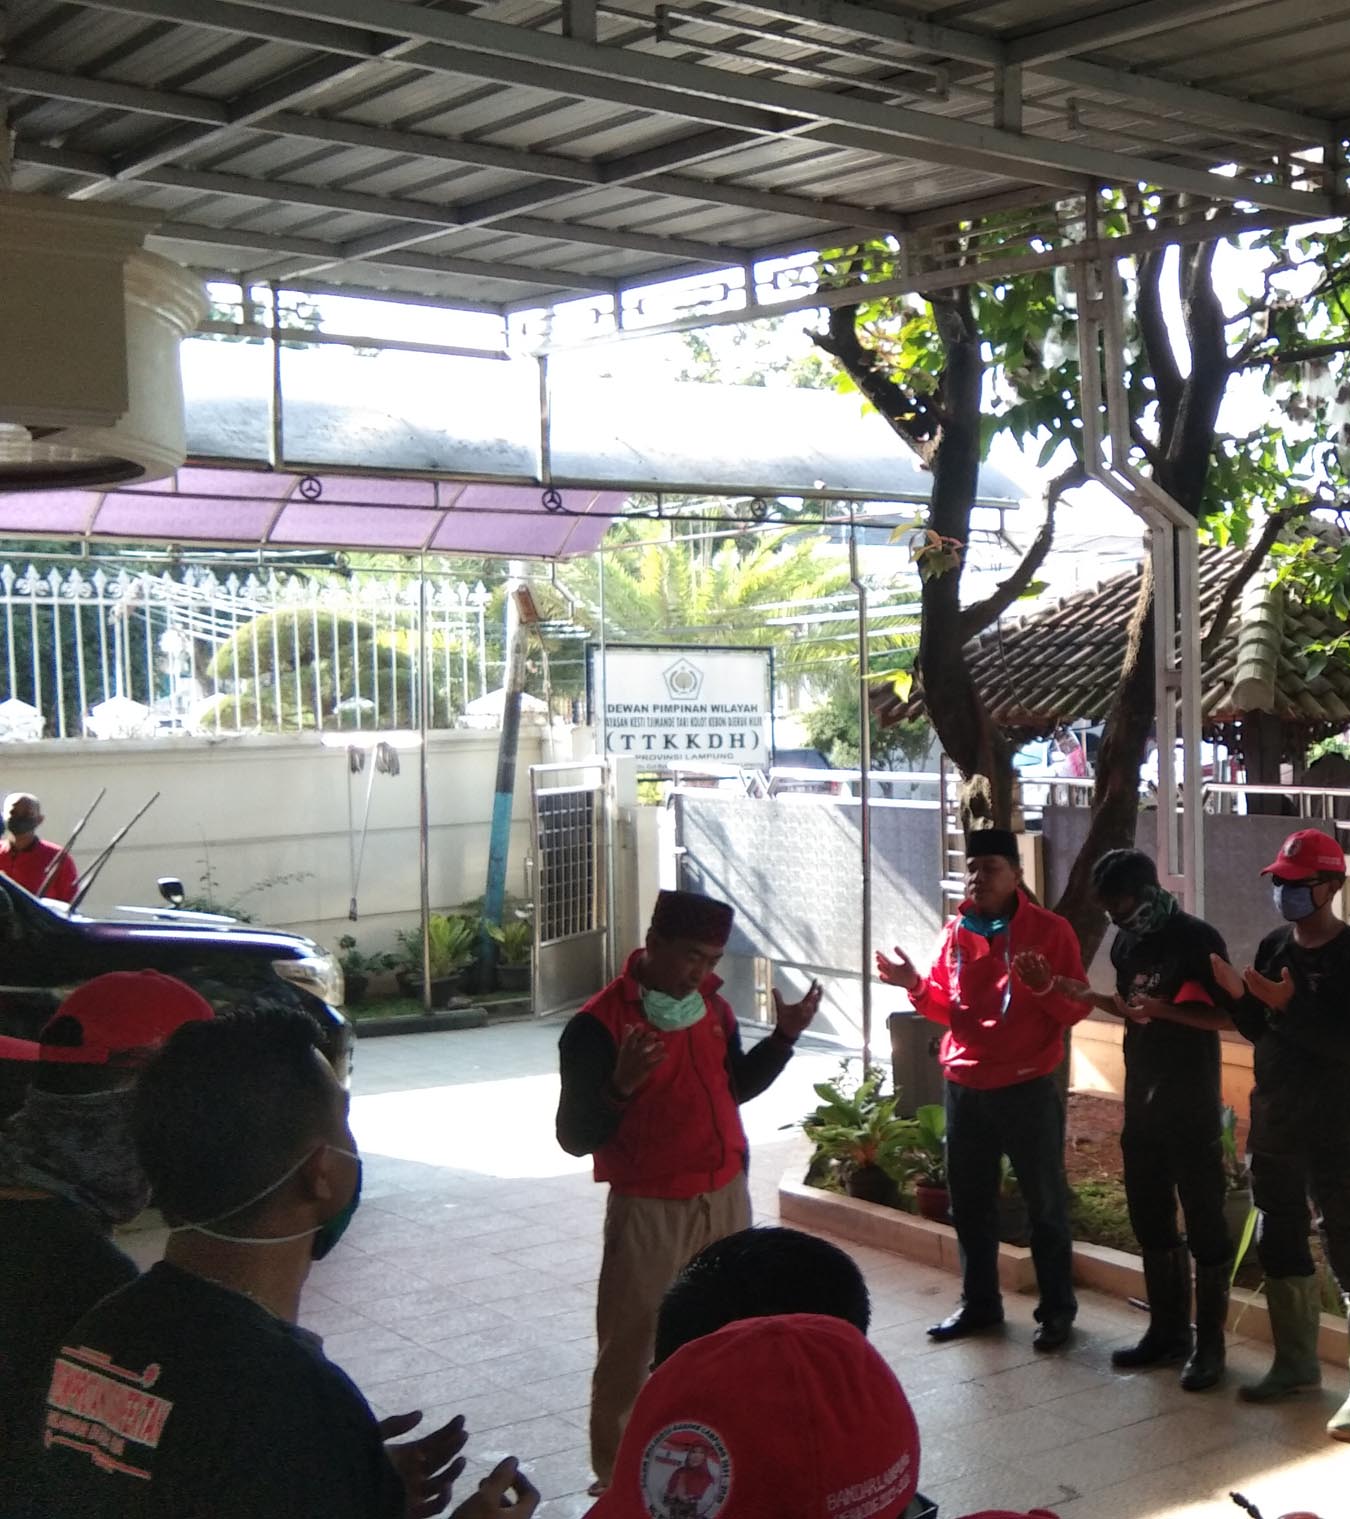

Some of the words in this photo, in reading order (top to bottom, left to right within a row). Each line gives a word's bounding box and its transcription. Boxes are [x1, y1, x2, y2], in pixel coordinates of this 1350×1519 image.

[608, 703, 649, 714] DEWAN
[652, 703, 707, 714] PIMPINAN
[711, 703, 758, 714] WILAYAH
[635, 753, 683, 761] PROVINSI
[685, 753, 735, 761] LAMPUNG
